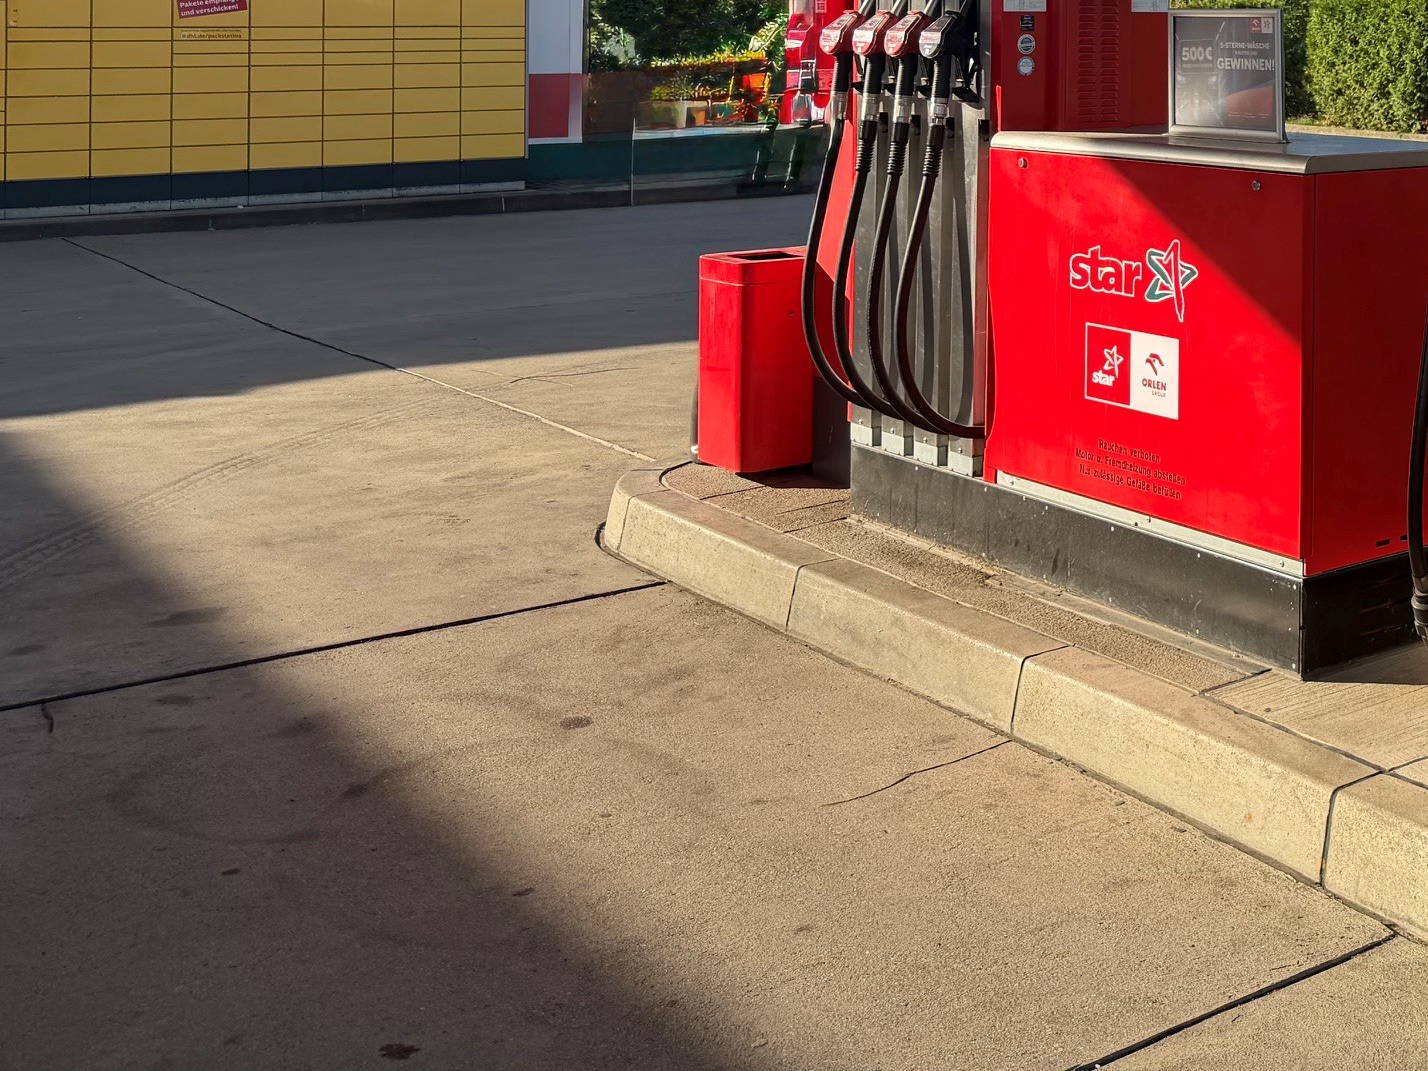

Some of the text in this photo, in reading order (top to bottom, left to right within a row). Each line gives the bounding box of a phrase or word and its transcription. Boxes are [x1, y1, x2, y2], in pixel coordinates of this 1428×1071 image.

[180, 0, 204, 8] Pakete
[195, 3, 239, 15] verschicken!
[1181, 46, 1213, 61] 500€
[1217, 57, 1275, 71] GEWINNEN!
[1070, 245, 1142, 297] star
[1091, 370, 1115, 387] star
[1142, 378, 1167, 391] ORLEN
[1098, 439, 1161, 463] Rauchen verboten
[1076, 448, 1095, 461] Motor
[1105, 455, 1151, 478] Fremdheizung
[1079, 464, 1181, 499] Nur zulässige Gefäße befüllen
